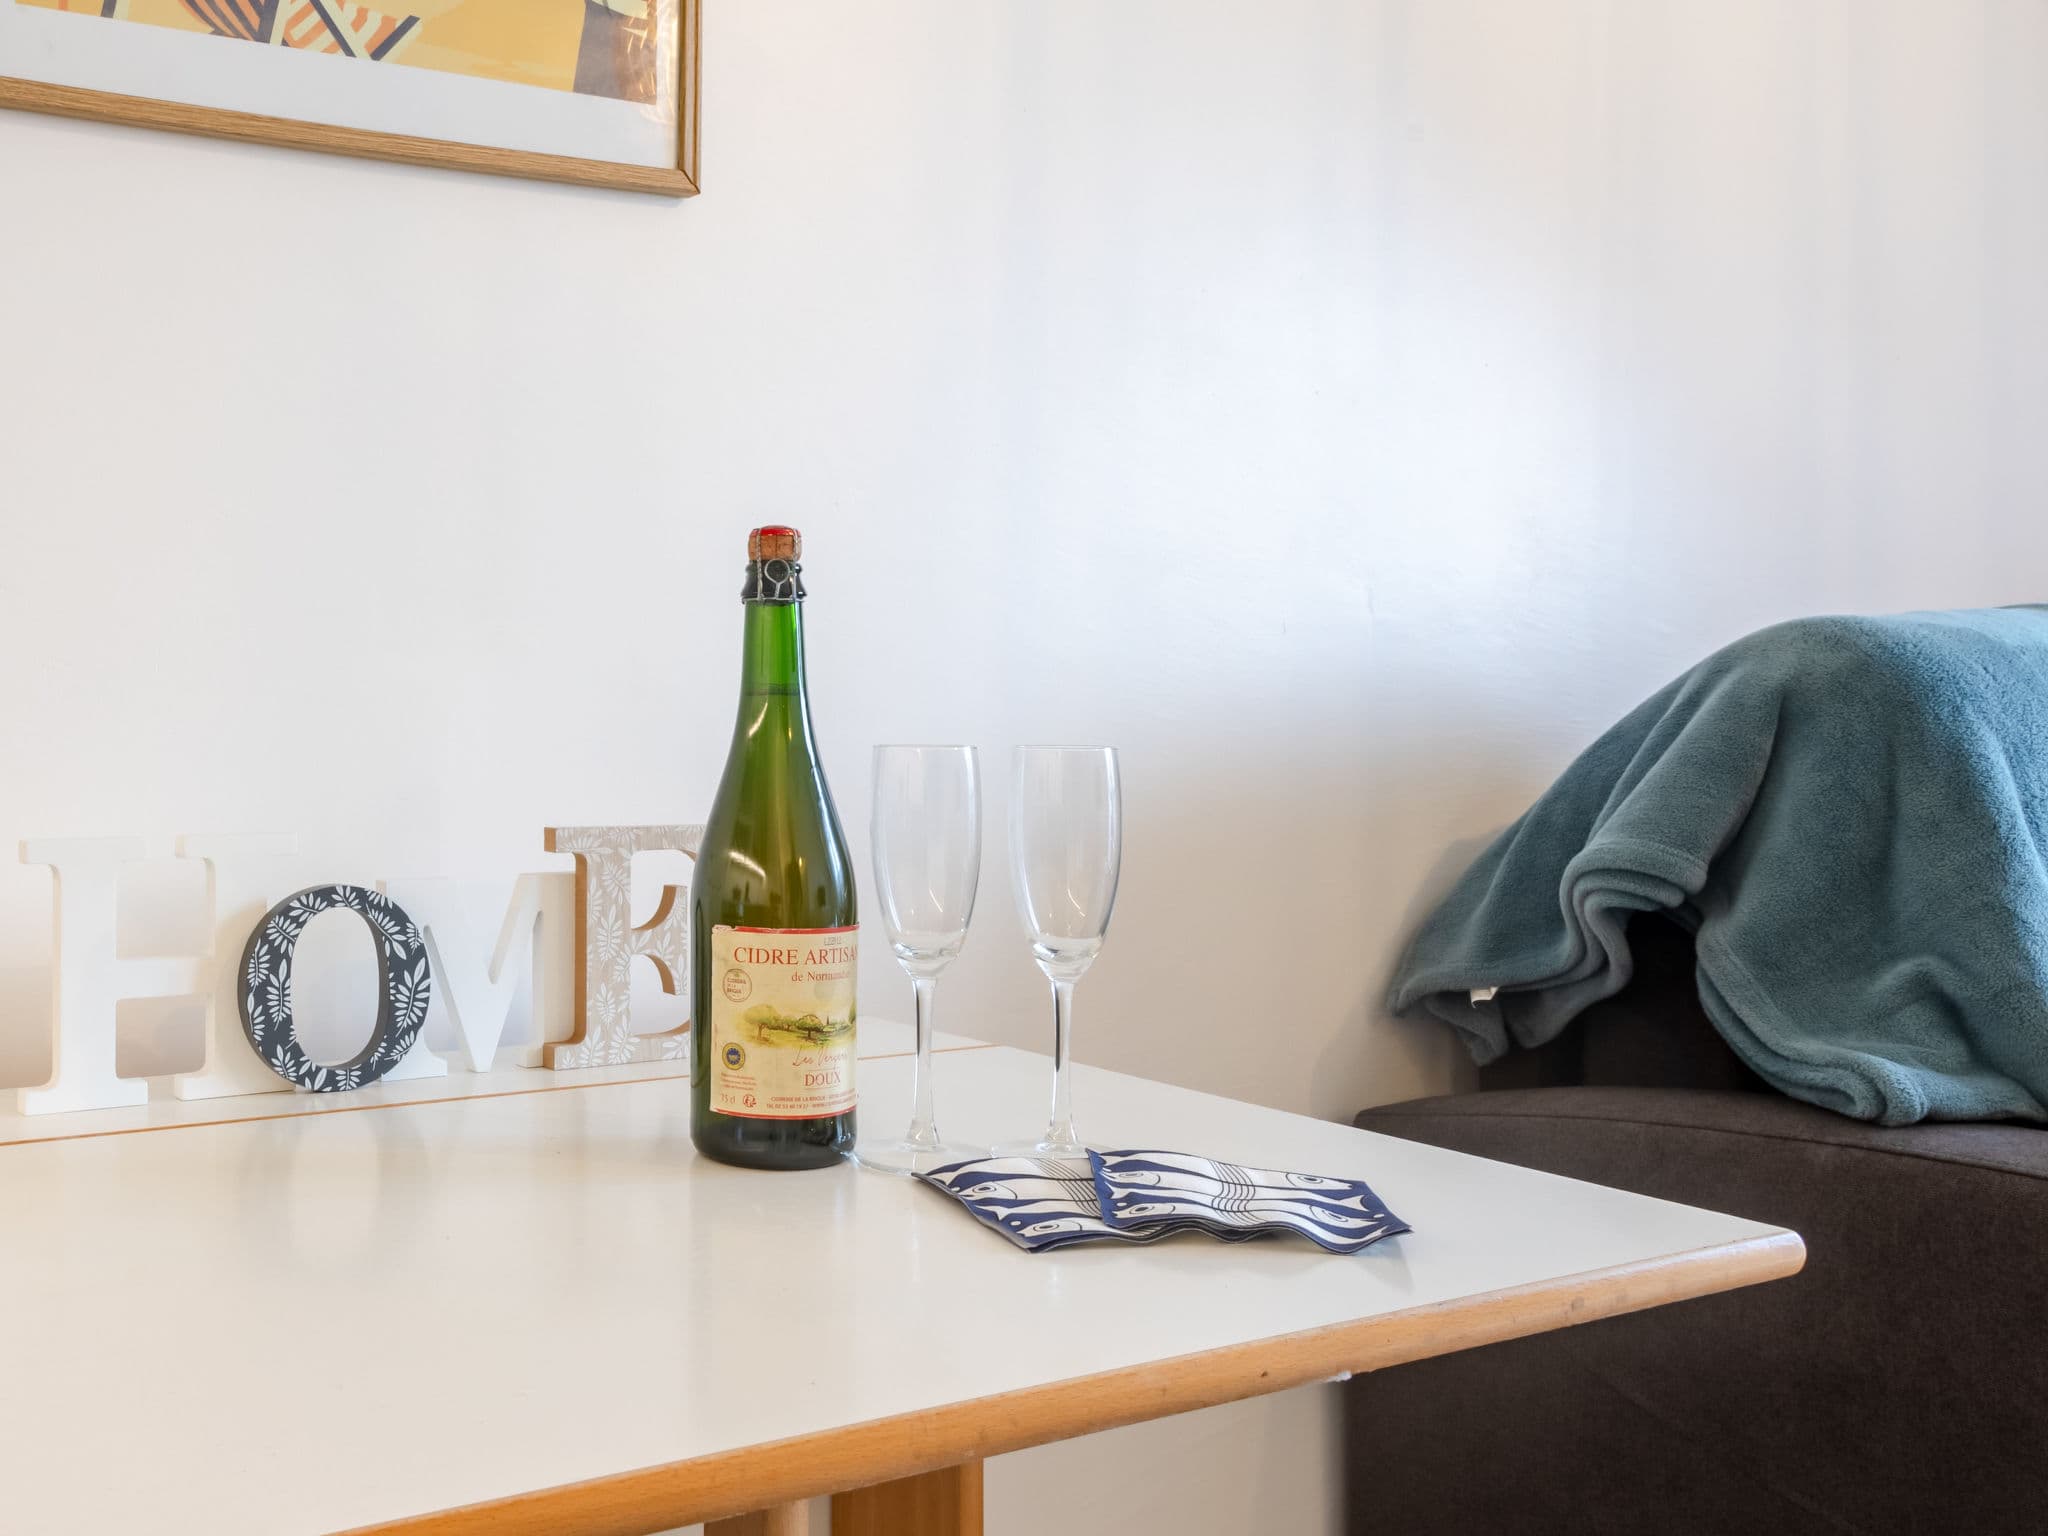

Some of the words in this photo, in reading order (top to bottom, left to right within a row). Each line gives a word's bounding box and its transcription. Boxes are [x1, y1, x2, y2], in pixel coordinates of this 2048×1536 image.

[734, 946, 799, 965] CIDRE
[791, 970, 803, 982] de
[804, 1071, 841, 1087] DOUX
